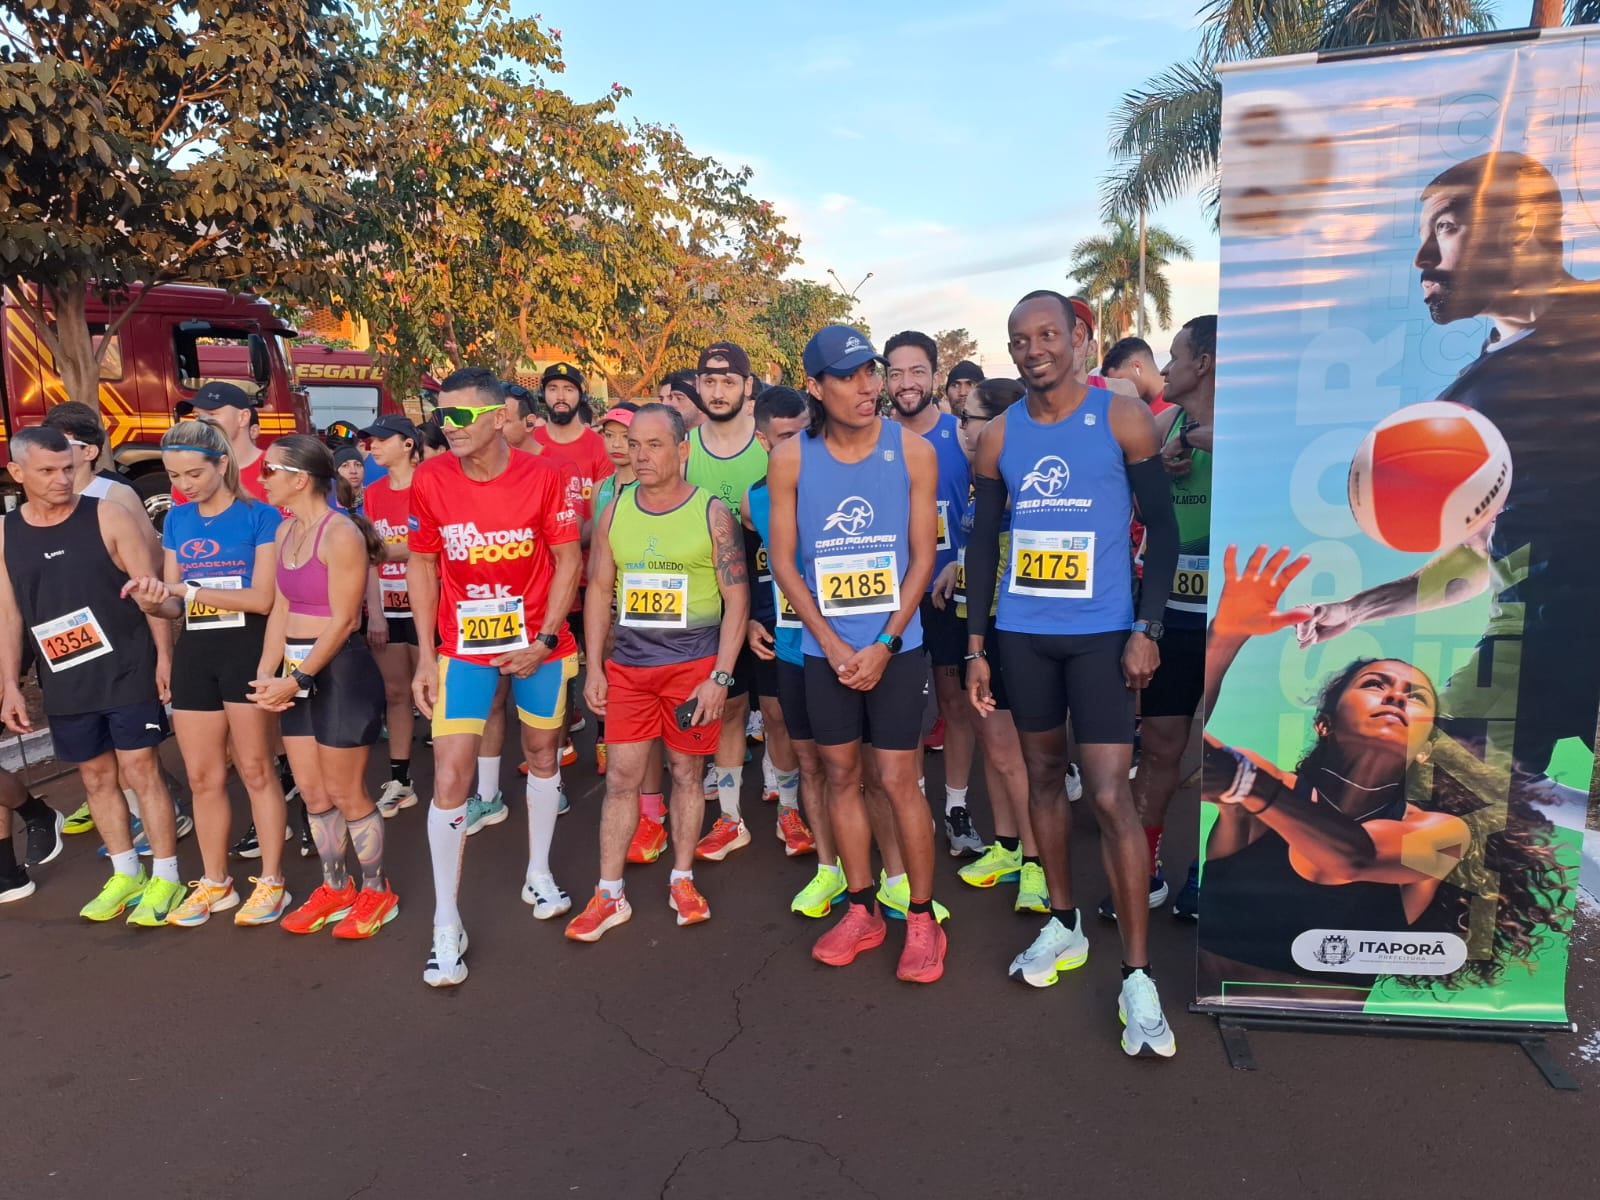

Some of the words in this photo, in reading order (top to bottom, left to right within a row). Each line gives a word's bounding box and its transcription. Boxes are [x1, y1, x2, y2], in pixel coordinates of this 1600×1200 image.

[1041, 498, 1092, 508] POMPEU
[845, 534, 897, 545] POMPEU
[469, 539, 534, 565] FOGO
[185, 560, 246, 570] ACADEMIA
[624, 562, 646, 570] TEAM
[648, 561, 684, 571] OLMEDO
[1021, 552, 1079, 580] 2175
[829, 572, 886, 599] 2185
[630, 591, 676, 613] 2182
[467, 615, 514, 640] 2074
[46, 626, 94, 658] 1354
[1359, 940, 1446, 955] ITAPORÃ
